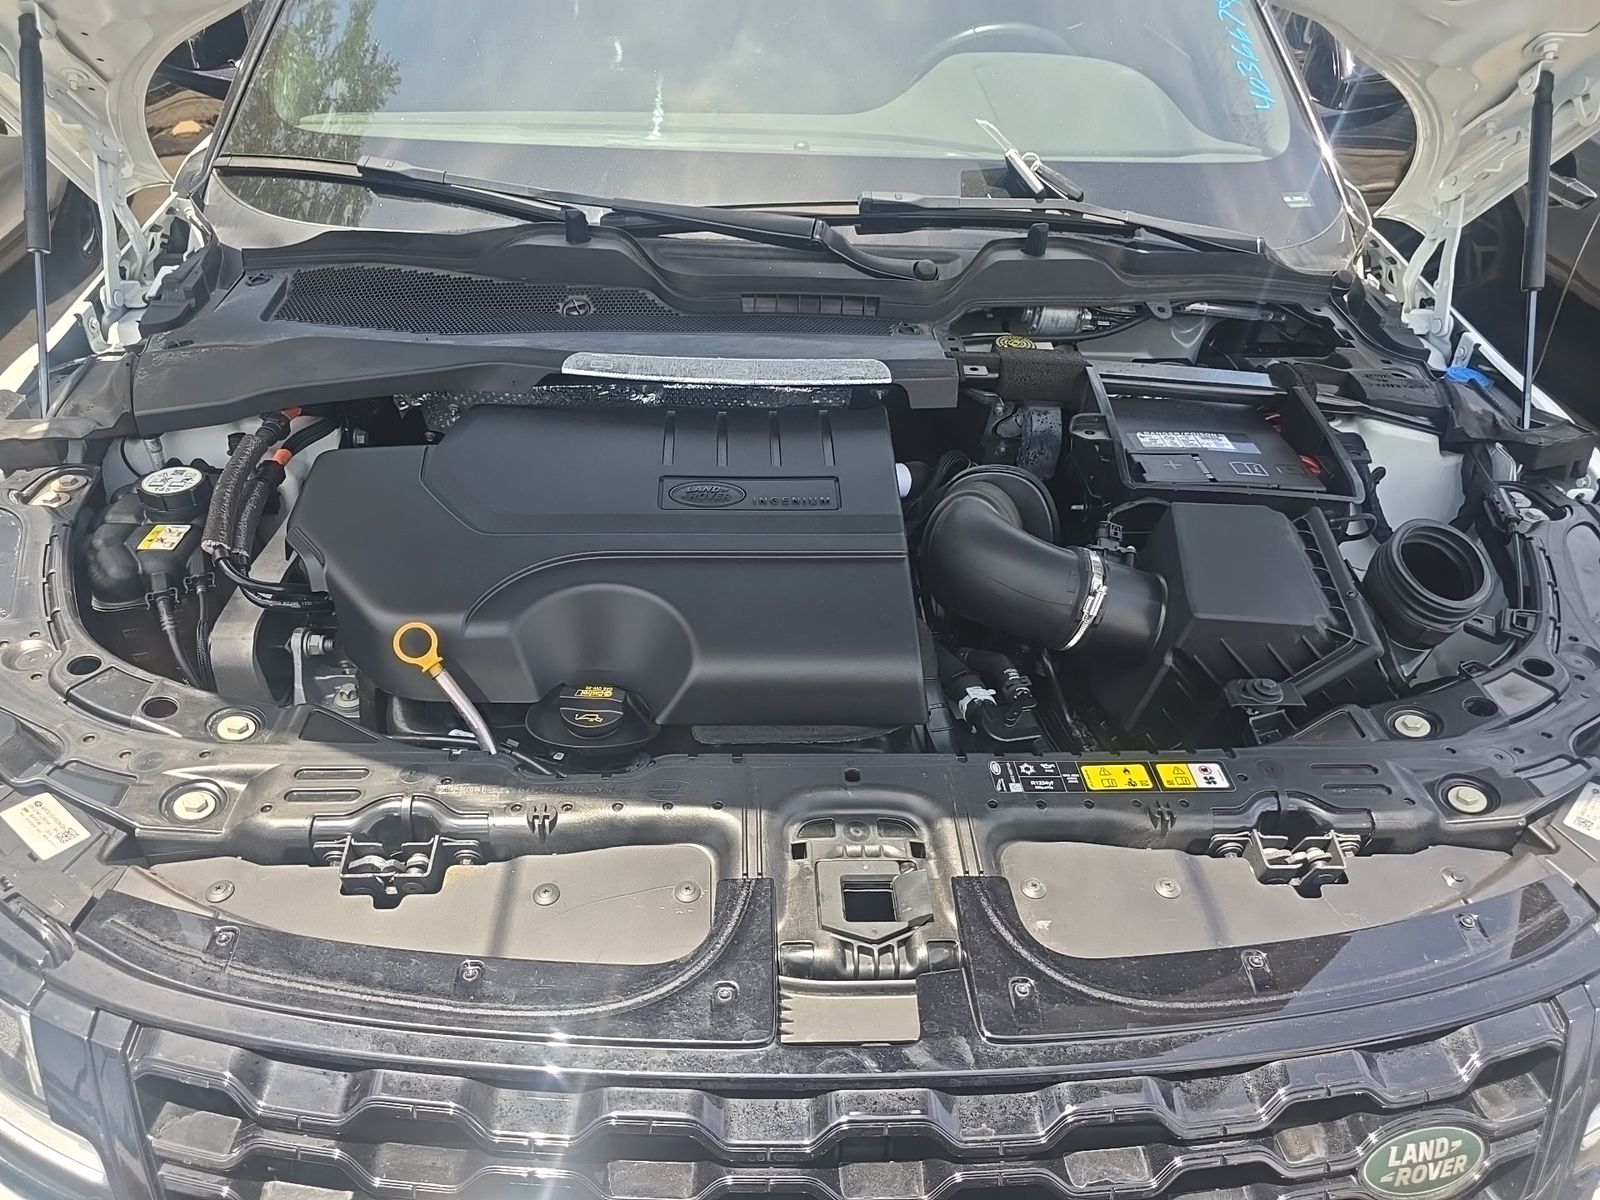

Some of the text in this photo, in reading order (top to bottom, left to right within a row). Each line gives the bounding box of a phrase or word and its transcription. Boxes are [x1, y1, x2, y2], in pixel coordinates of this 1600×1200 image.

[685, 485, 721, 494] LAND
[686, 492, 731, 503] ROVER
[752, 496, 832, 506] INGENIUM
[1388, 1137, 1449, 1167] LAND
[1394, 1154, 1468, 1187] ROVER
